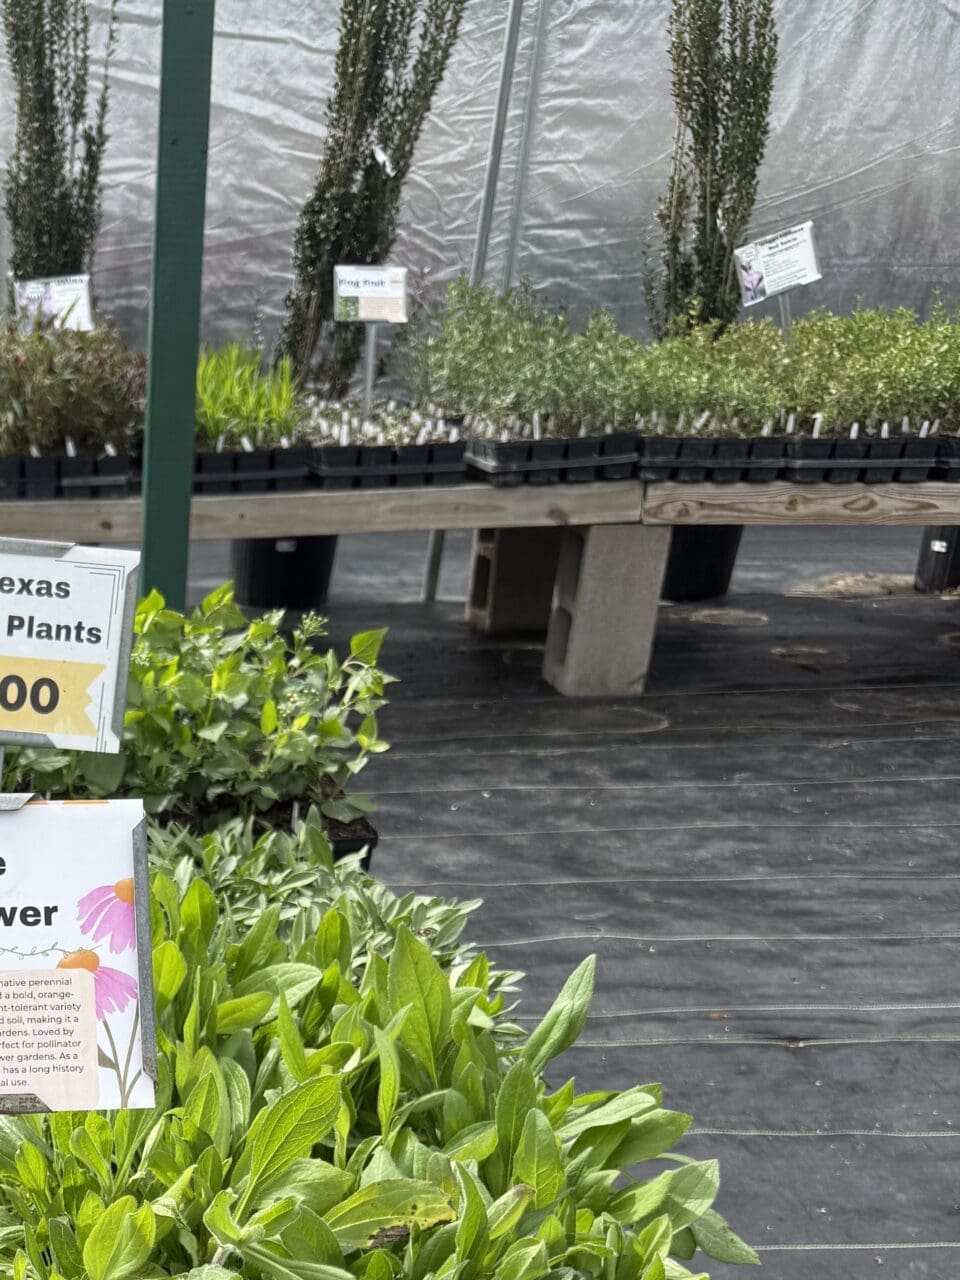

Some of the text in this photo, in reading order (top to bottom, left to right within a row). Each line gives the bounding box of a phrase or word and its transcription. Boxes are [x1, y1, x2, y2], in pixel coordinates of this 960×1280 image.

[7, 615, 102, 644] Plants
[29, 978, 72, 987] perennial
[13, 992, 36, 1000] bold,
[7, 1016, 24, 1025] soil,
[27, 1015, 62, 1024] making
[65, 1015, 71, 1023] it
[33, 1028, 60, 1036] Loved
[63, 1028, 74, 1036] by
[22, 1041, 34, 1049] for
[37, 1040, 81, 1049] pollinator
[17, 1053, 57, 1062] gardens.
[59, 1052, 70, 1060] As
[30, 1066, 50, 1074] long
[53, 1065, 84, 1073] history
